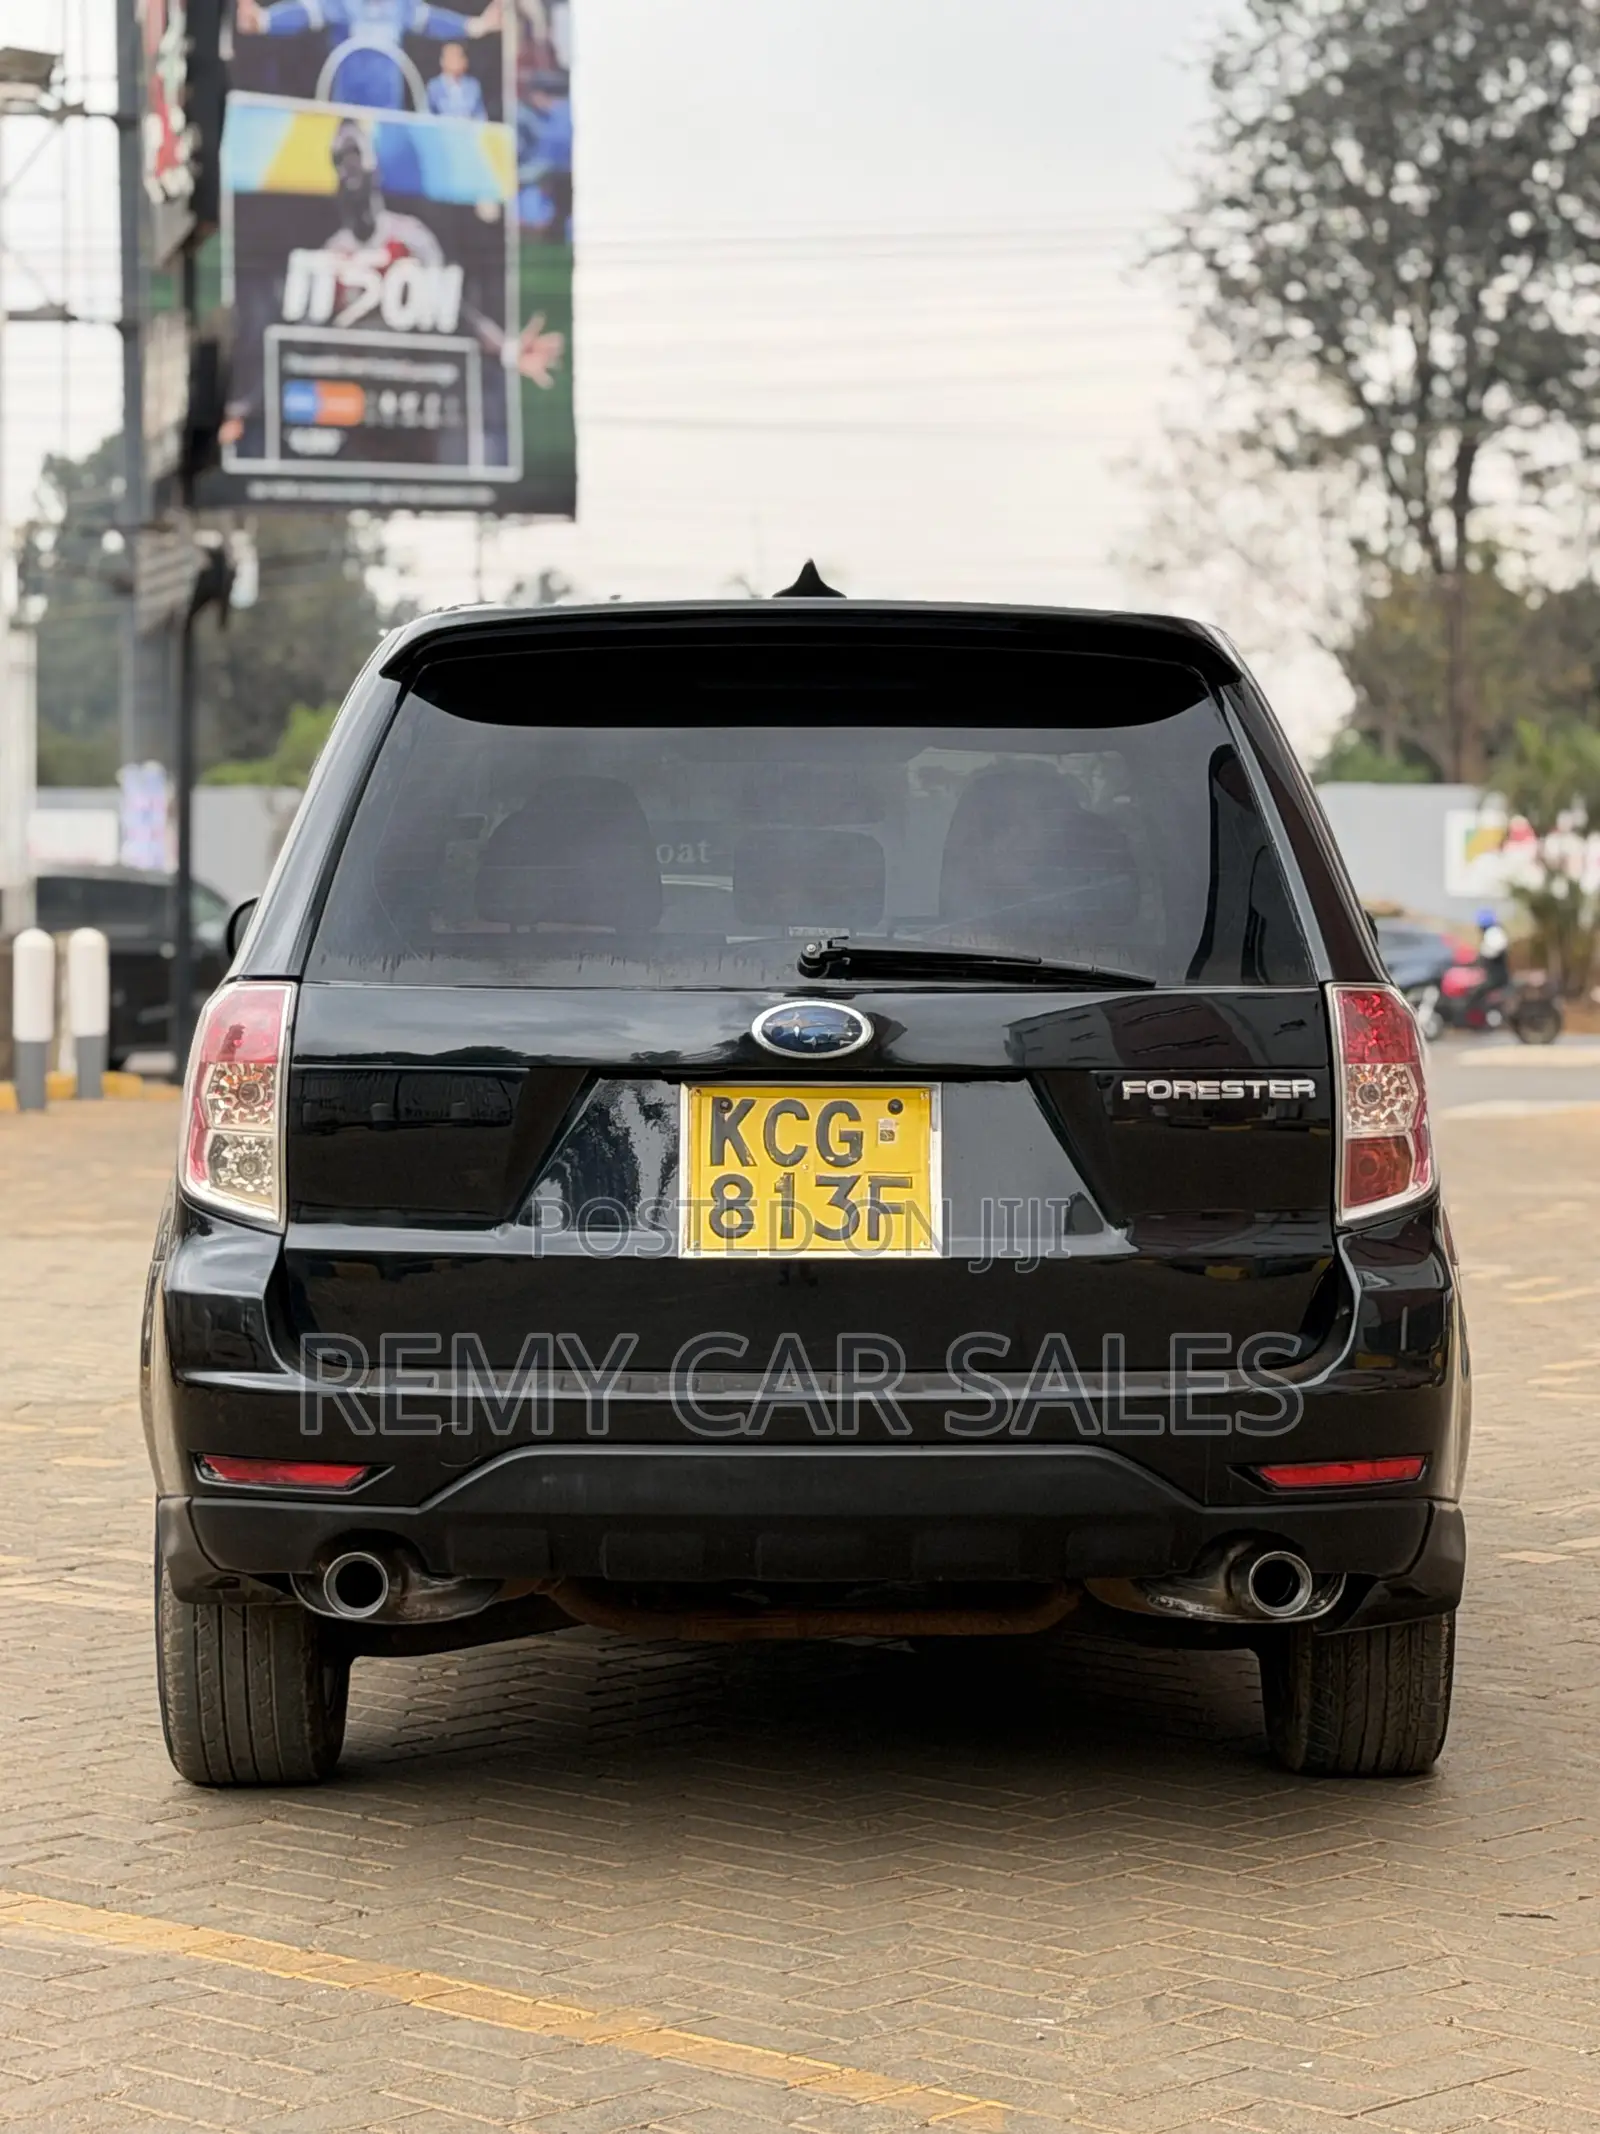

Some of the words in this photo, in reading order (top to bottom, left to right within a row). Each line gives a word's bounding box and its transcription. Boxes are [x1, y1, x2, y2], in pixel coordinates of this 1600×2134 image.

[1121, 1079, 1317, 1100] FORESTER
[709, 1096, 864, 1168] KCG
[708, 1171, 913, 1242] 813F
